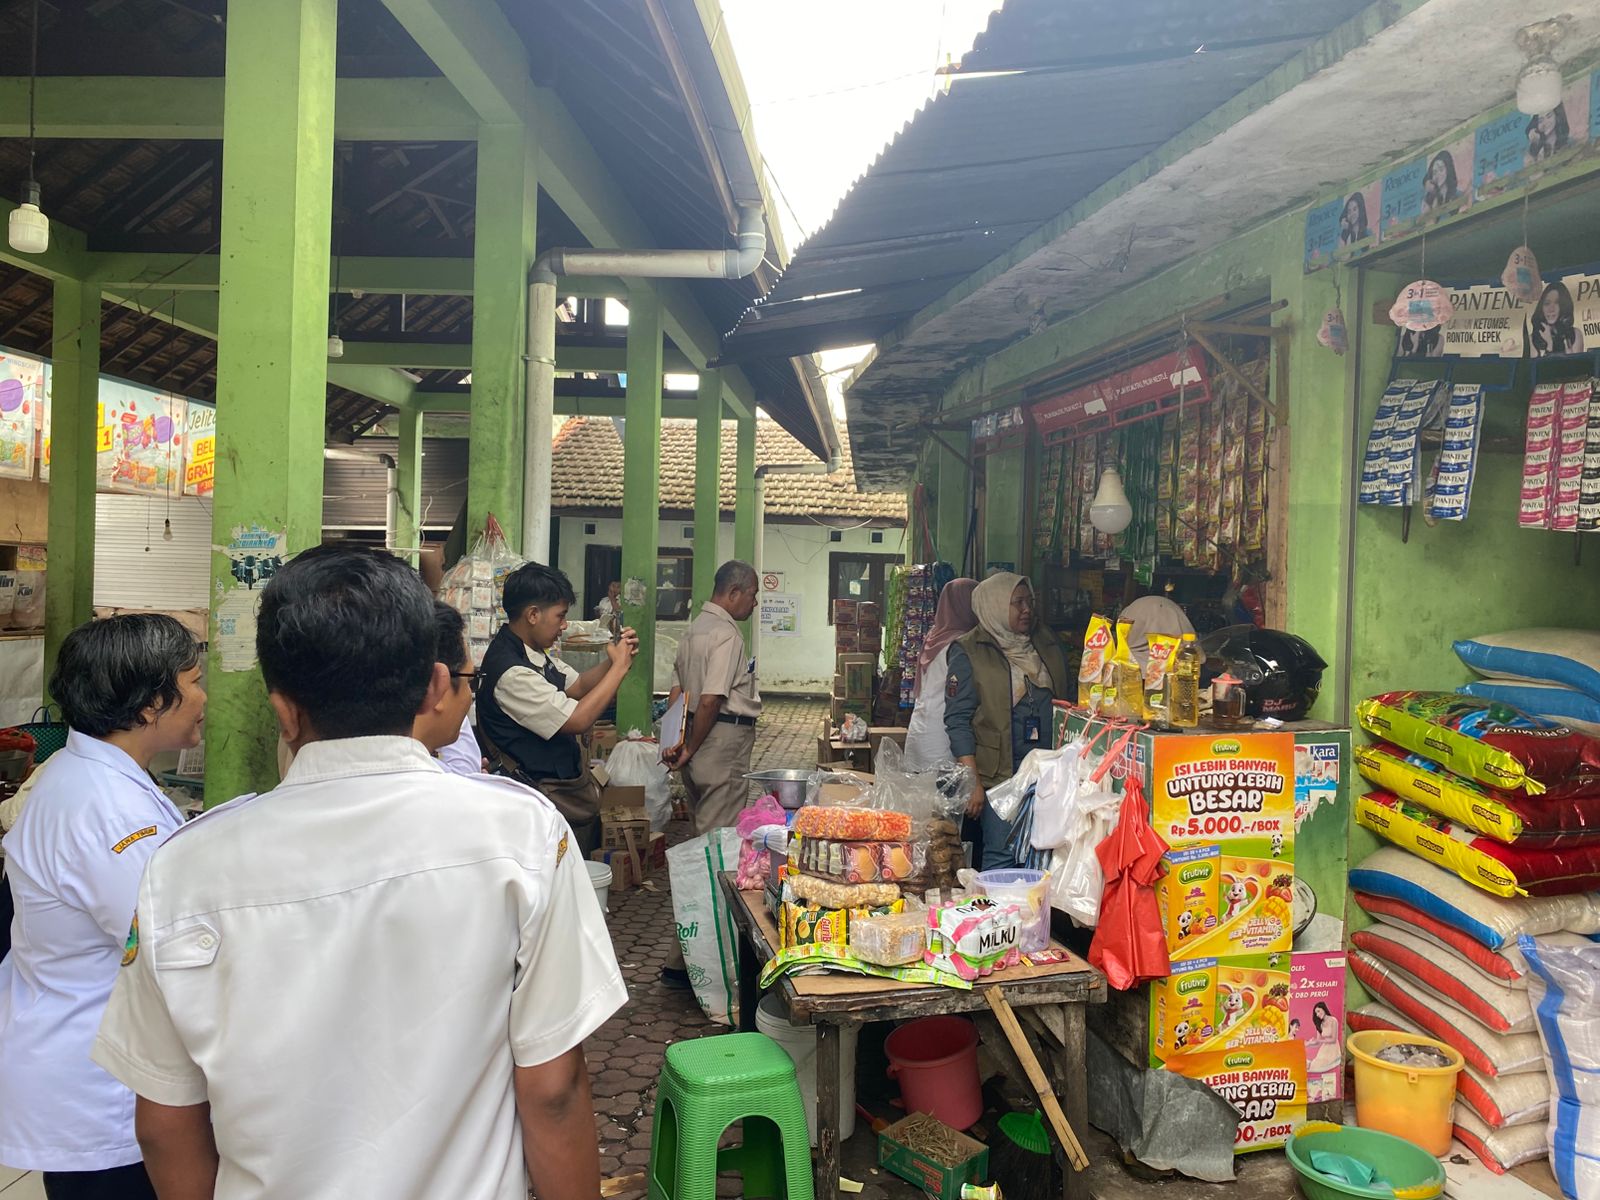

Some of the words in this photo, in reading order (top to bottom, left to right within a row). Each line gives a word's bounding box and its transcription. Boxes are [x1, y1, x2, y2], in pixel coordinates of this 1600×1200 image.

[1473, 317, 1511, 330] KETOMBE,
[1446, 331, 1477, 344] RONTOK,
[1478, 331, 1501, 343] LEPEK
[1312, 746, 1336, 760] kara
[1175, 762, 1191, 777] ISI
[1193, 760, 1227, 774] LEBIH
[1229, 759, 1277, 773] BANYAK
[1168, 774, 1234, 794] UNTUNG
[1238, 773, 1283, 790] LEBIH
[1191, 791, 1262, 812] BESAR
[1171, 825, 1186, 837] Rp
[1316, 980, 1338, 988] SEHARI
[1206, 1072, 1240, 1087] LEBIH
[1242, 1069, 1289, 1083] BANYAK
[1251, 1082, 1295, 1098] LEBIH
